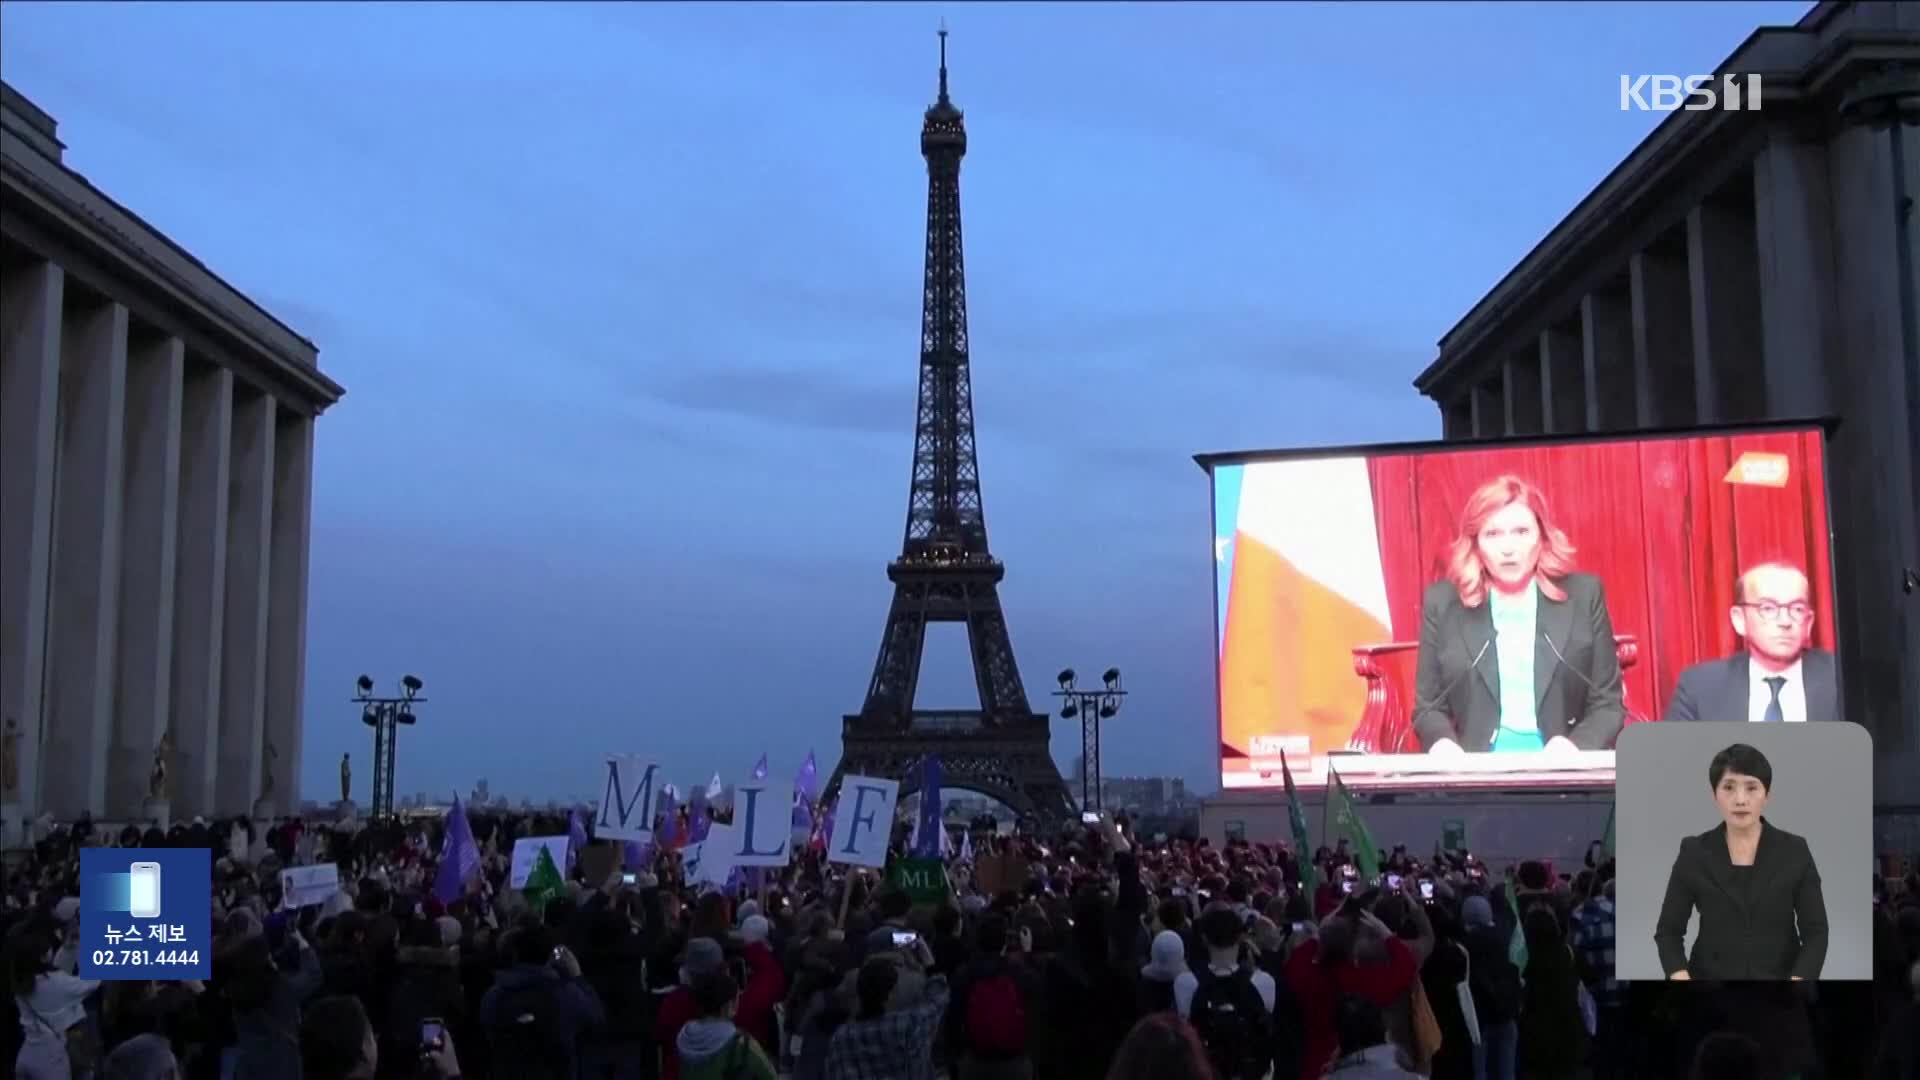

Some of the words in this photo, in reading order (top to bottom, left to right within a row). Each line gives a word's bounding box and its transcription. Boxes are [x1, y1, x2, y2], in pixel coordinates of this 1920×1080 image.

[598, 761, 658, 830] M
[736, 787, 786, 856] L
[841, 785, 887, 854] F
